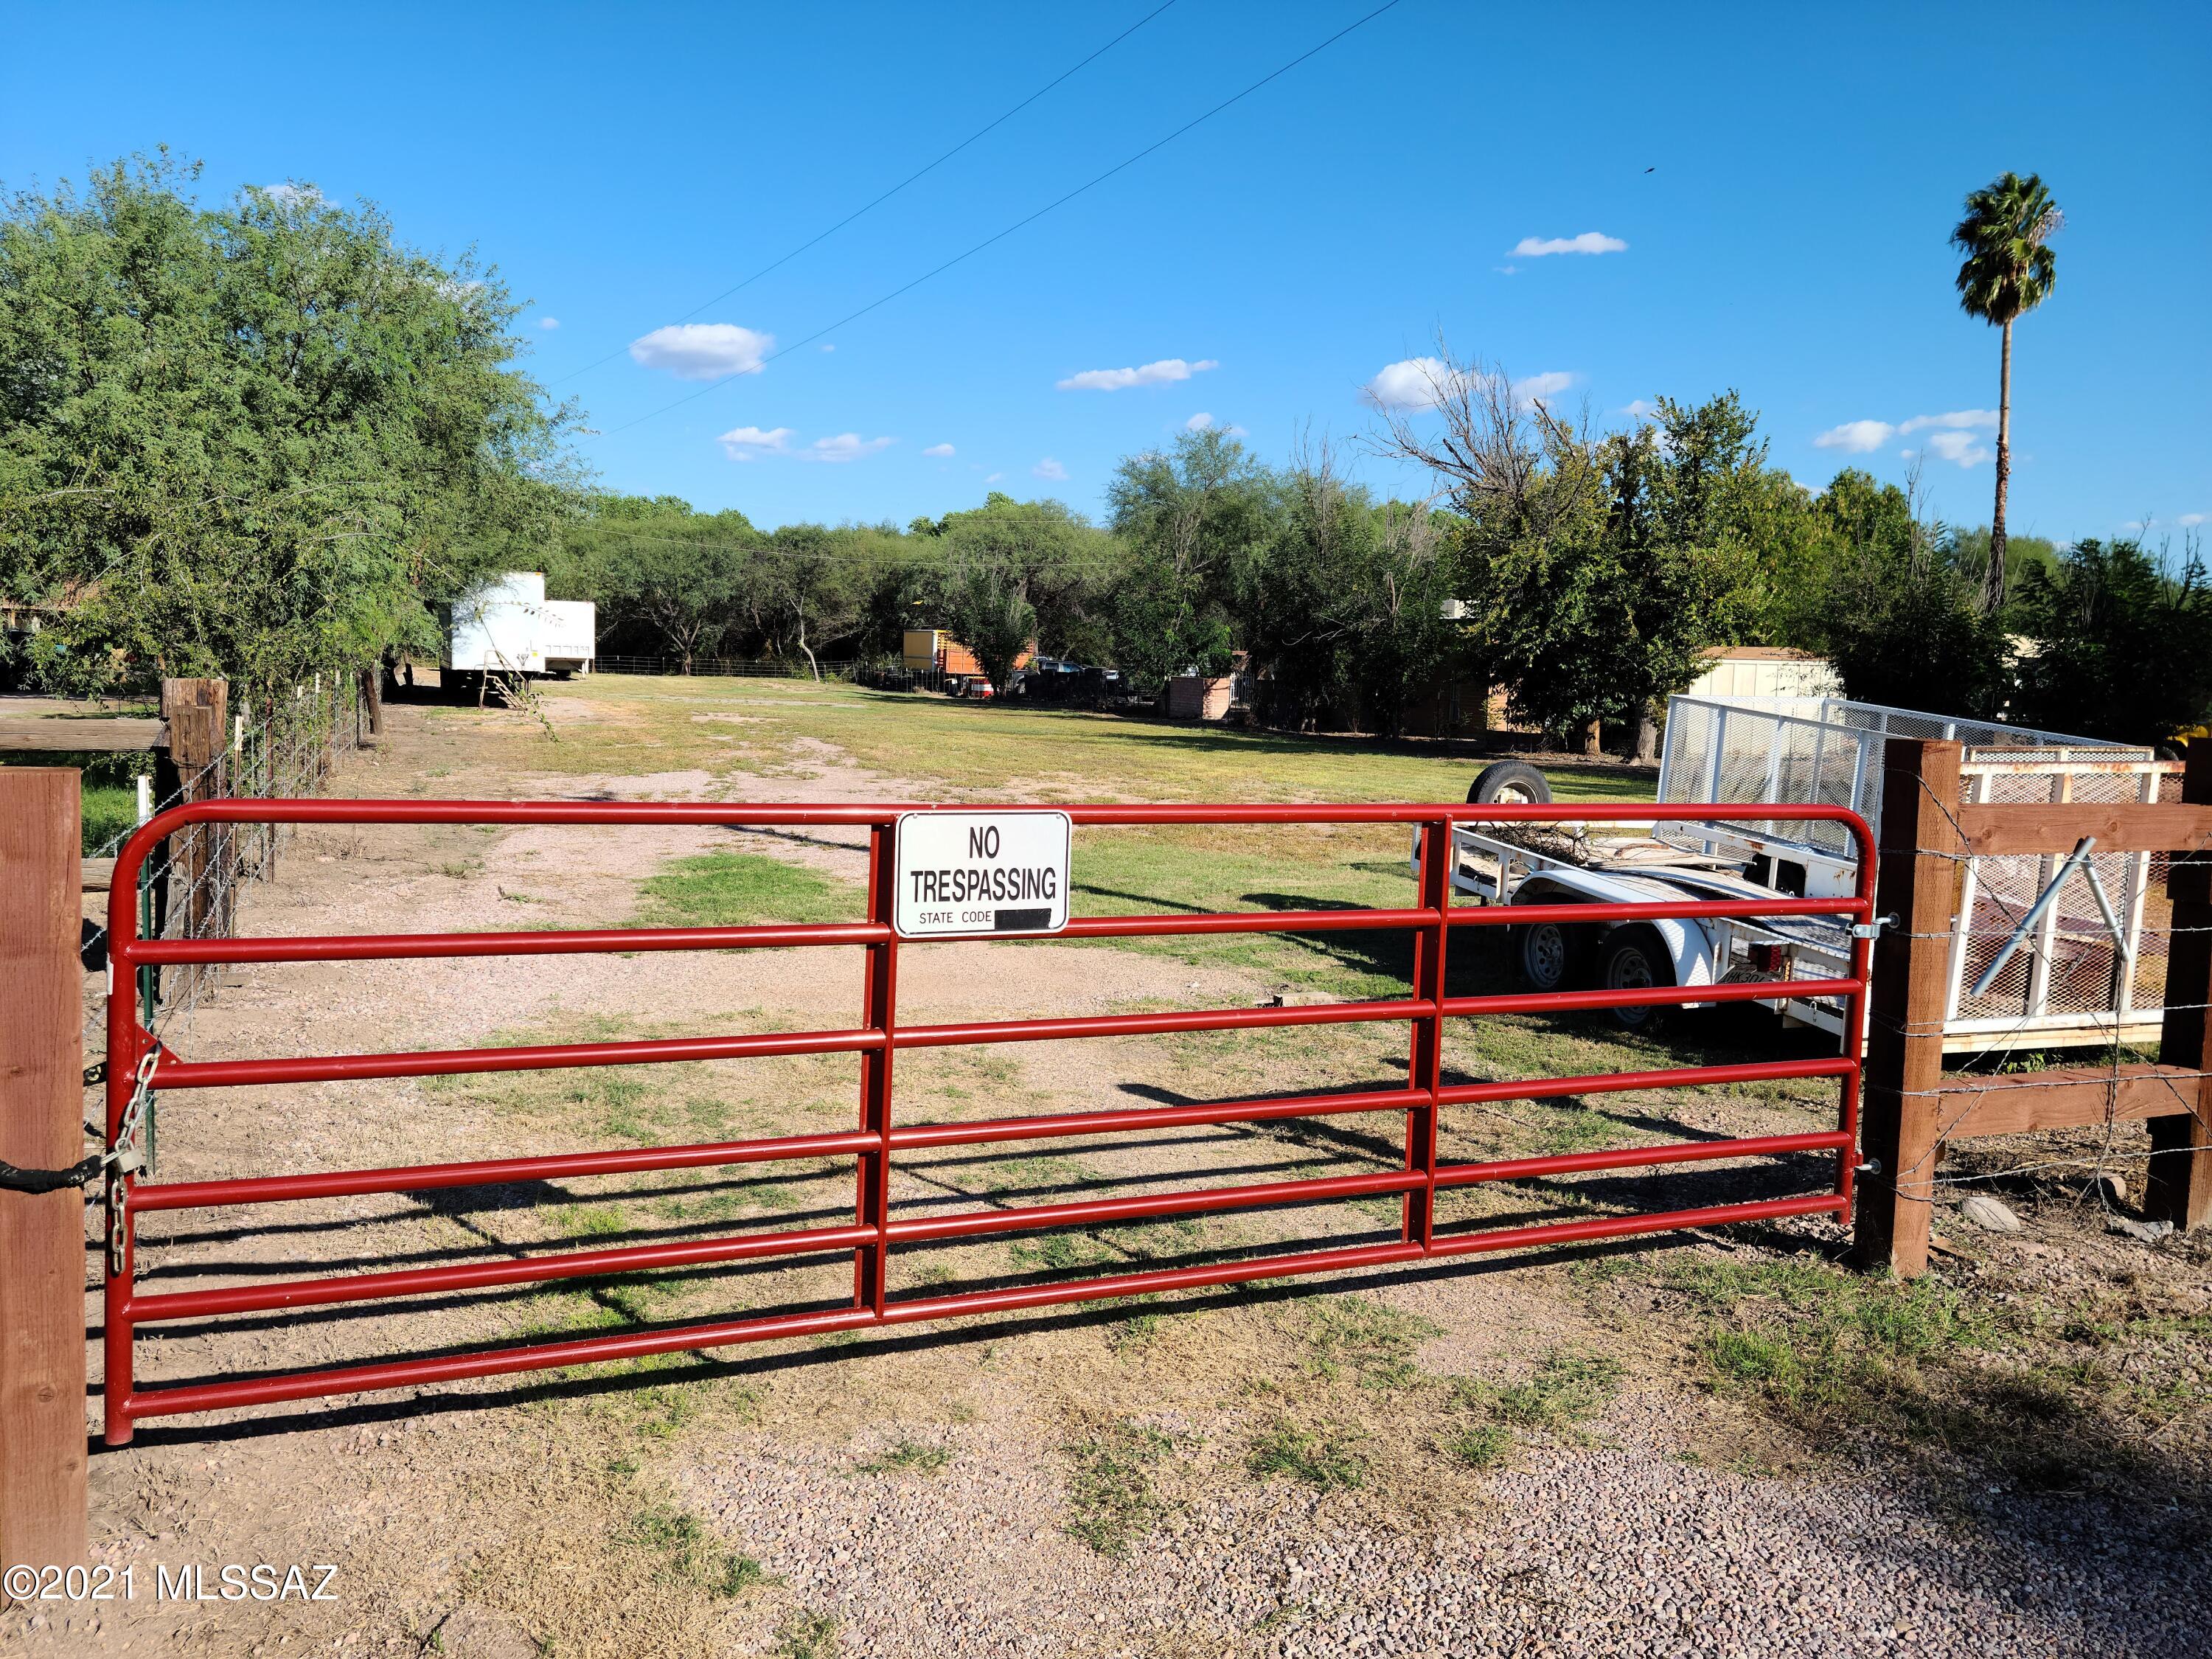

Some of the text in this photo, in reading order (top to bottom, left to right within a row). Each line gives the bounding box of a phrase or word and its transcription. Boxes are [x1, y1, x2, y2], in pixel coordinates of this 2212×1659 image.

[969, 825, 1000, 859] NO
[910, 866, 1056, 903] TRESPASSING
[919, 911, 992, 924] STATE CODE
